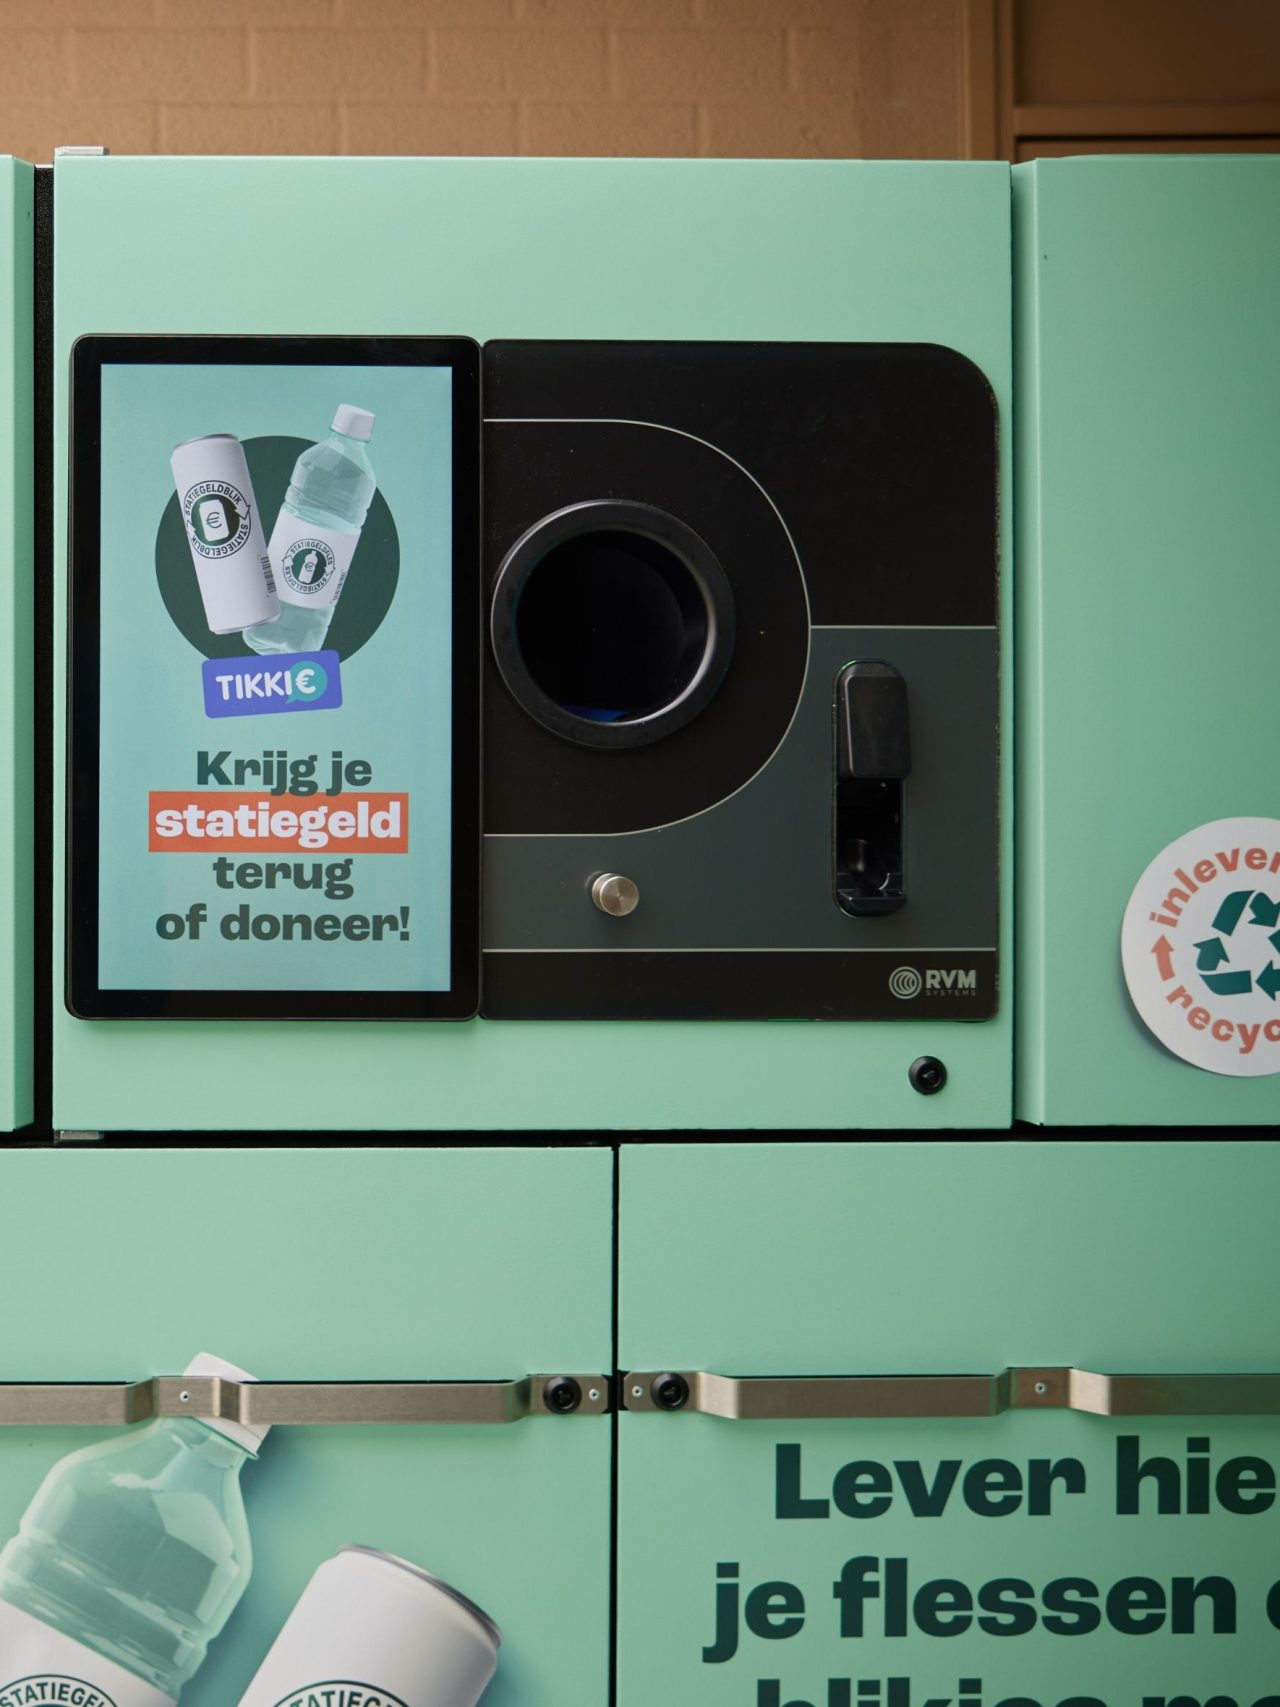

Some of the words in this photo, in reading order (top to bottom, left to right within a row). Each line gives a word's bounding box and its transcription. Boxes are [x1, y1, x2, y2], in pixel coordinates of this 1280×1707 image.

[185, 483, 243, 517] STATIEGELDBLIK
[191, 523, 249, 556] STATIEGELDBLIK
[290, 540, 333, 566] STATIEGELDFLES
[196, 750, 318, 797] Krijg
[325, 750, 372, 797] je
[155, 801, 401, 849] statiegeld
[212, 857, 354, 900] terug
[155, 903, 207, 940] of
[219, 904, 410, 941] doneer!
[925, 969, 977, 989] RVM
[775, 1443, 1086, 1519] Lever
[1116, 1435, 1276, 1515] hie
[702, 1562, 806, 1664] je
[832, 1555, 1237, 1638] flessen
[0, 1682, 105, 1707] STATIEGE
